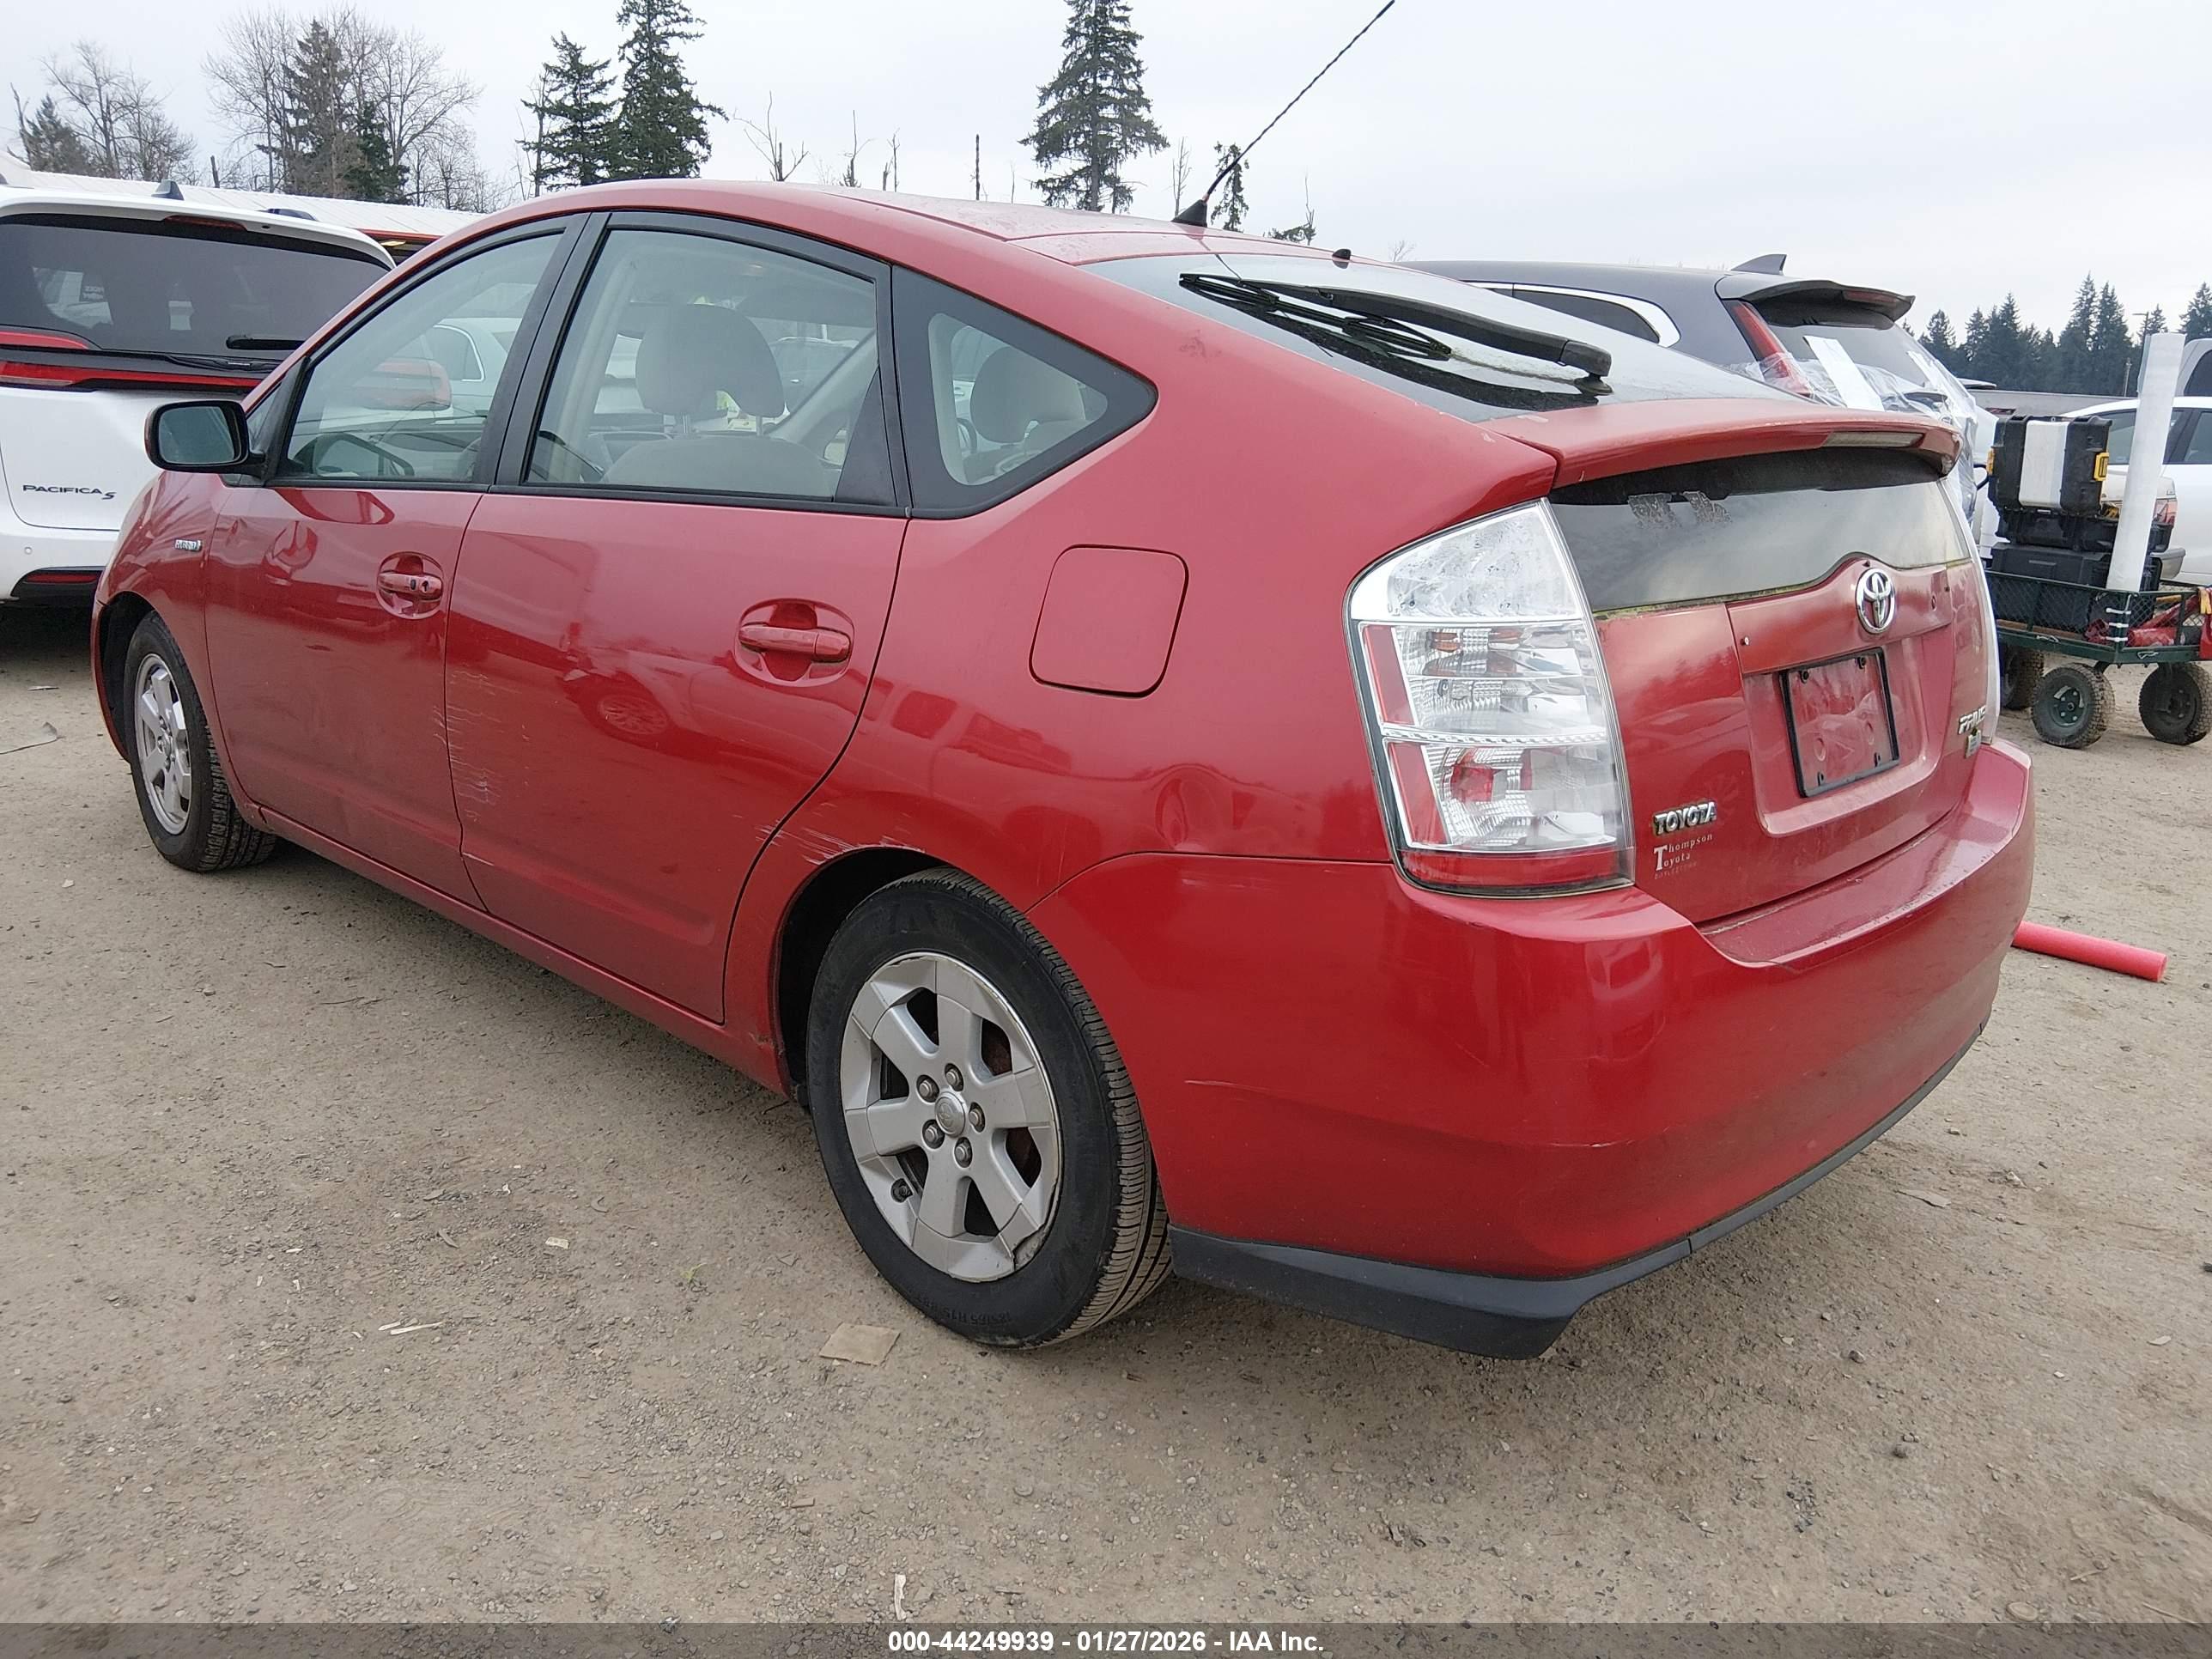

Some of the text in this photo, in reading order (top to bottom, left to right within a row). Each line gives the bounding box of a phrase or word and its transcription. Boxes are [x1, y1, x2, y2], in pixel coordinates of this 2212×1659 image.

[22, 484, 116, 501] PACIFICA S
[1655, 801, 1717, 834] TOYOTA
[1653, 833, 1713, 871] Thompson
